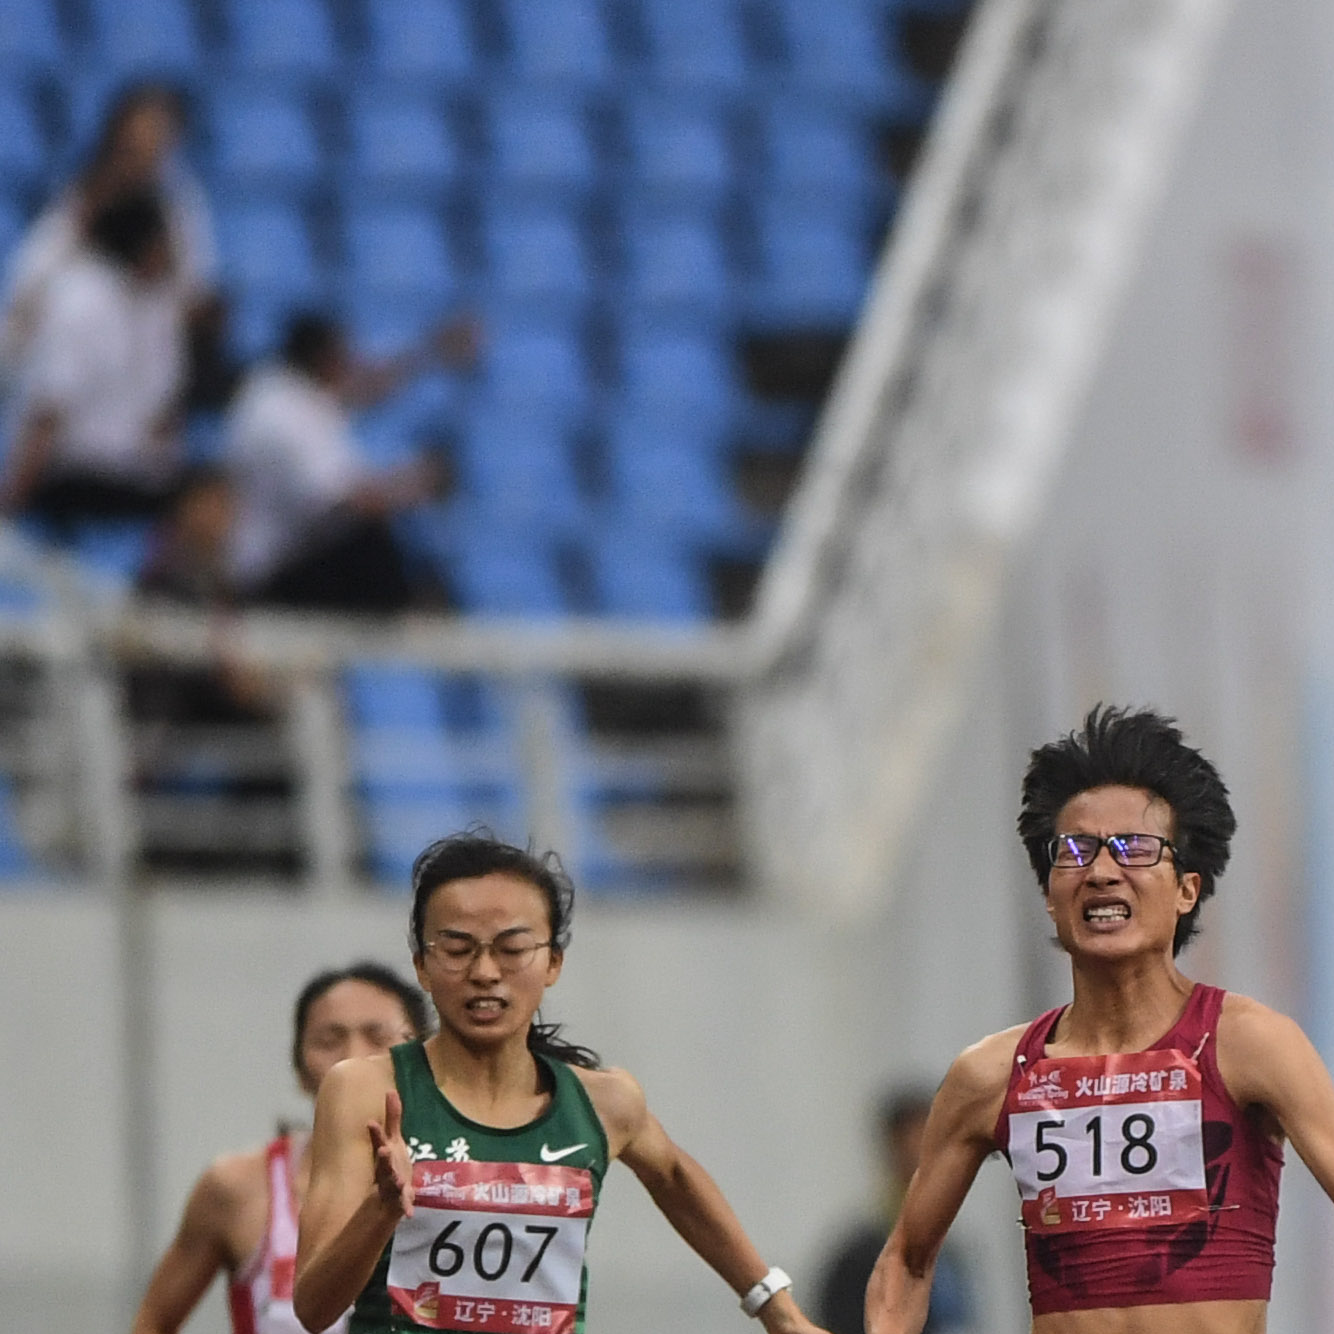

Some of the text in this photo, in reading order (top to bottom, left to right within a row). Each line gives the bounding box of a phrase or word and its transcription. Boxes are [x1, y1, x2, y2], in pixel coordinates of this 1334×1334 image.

[1075, 1069, 1187, 1097] 火山源冷矿泉
[408, 1137, 471, 1162] 江苏
[1036, 1113, 1158, 1181] 518
[1072, 1196, 1172, 1222] 辽宁·沈阳
[429, 1220, 558, 1282] 607
[454, 1300, 552, 1326] 辽宁·沈阳
